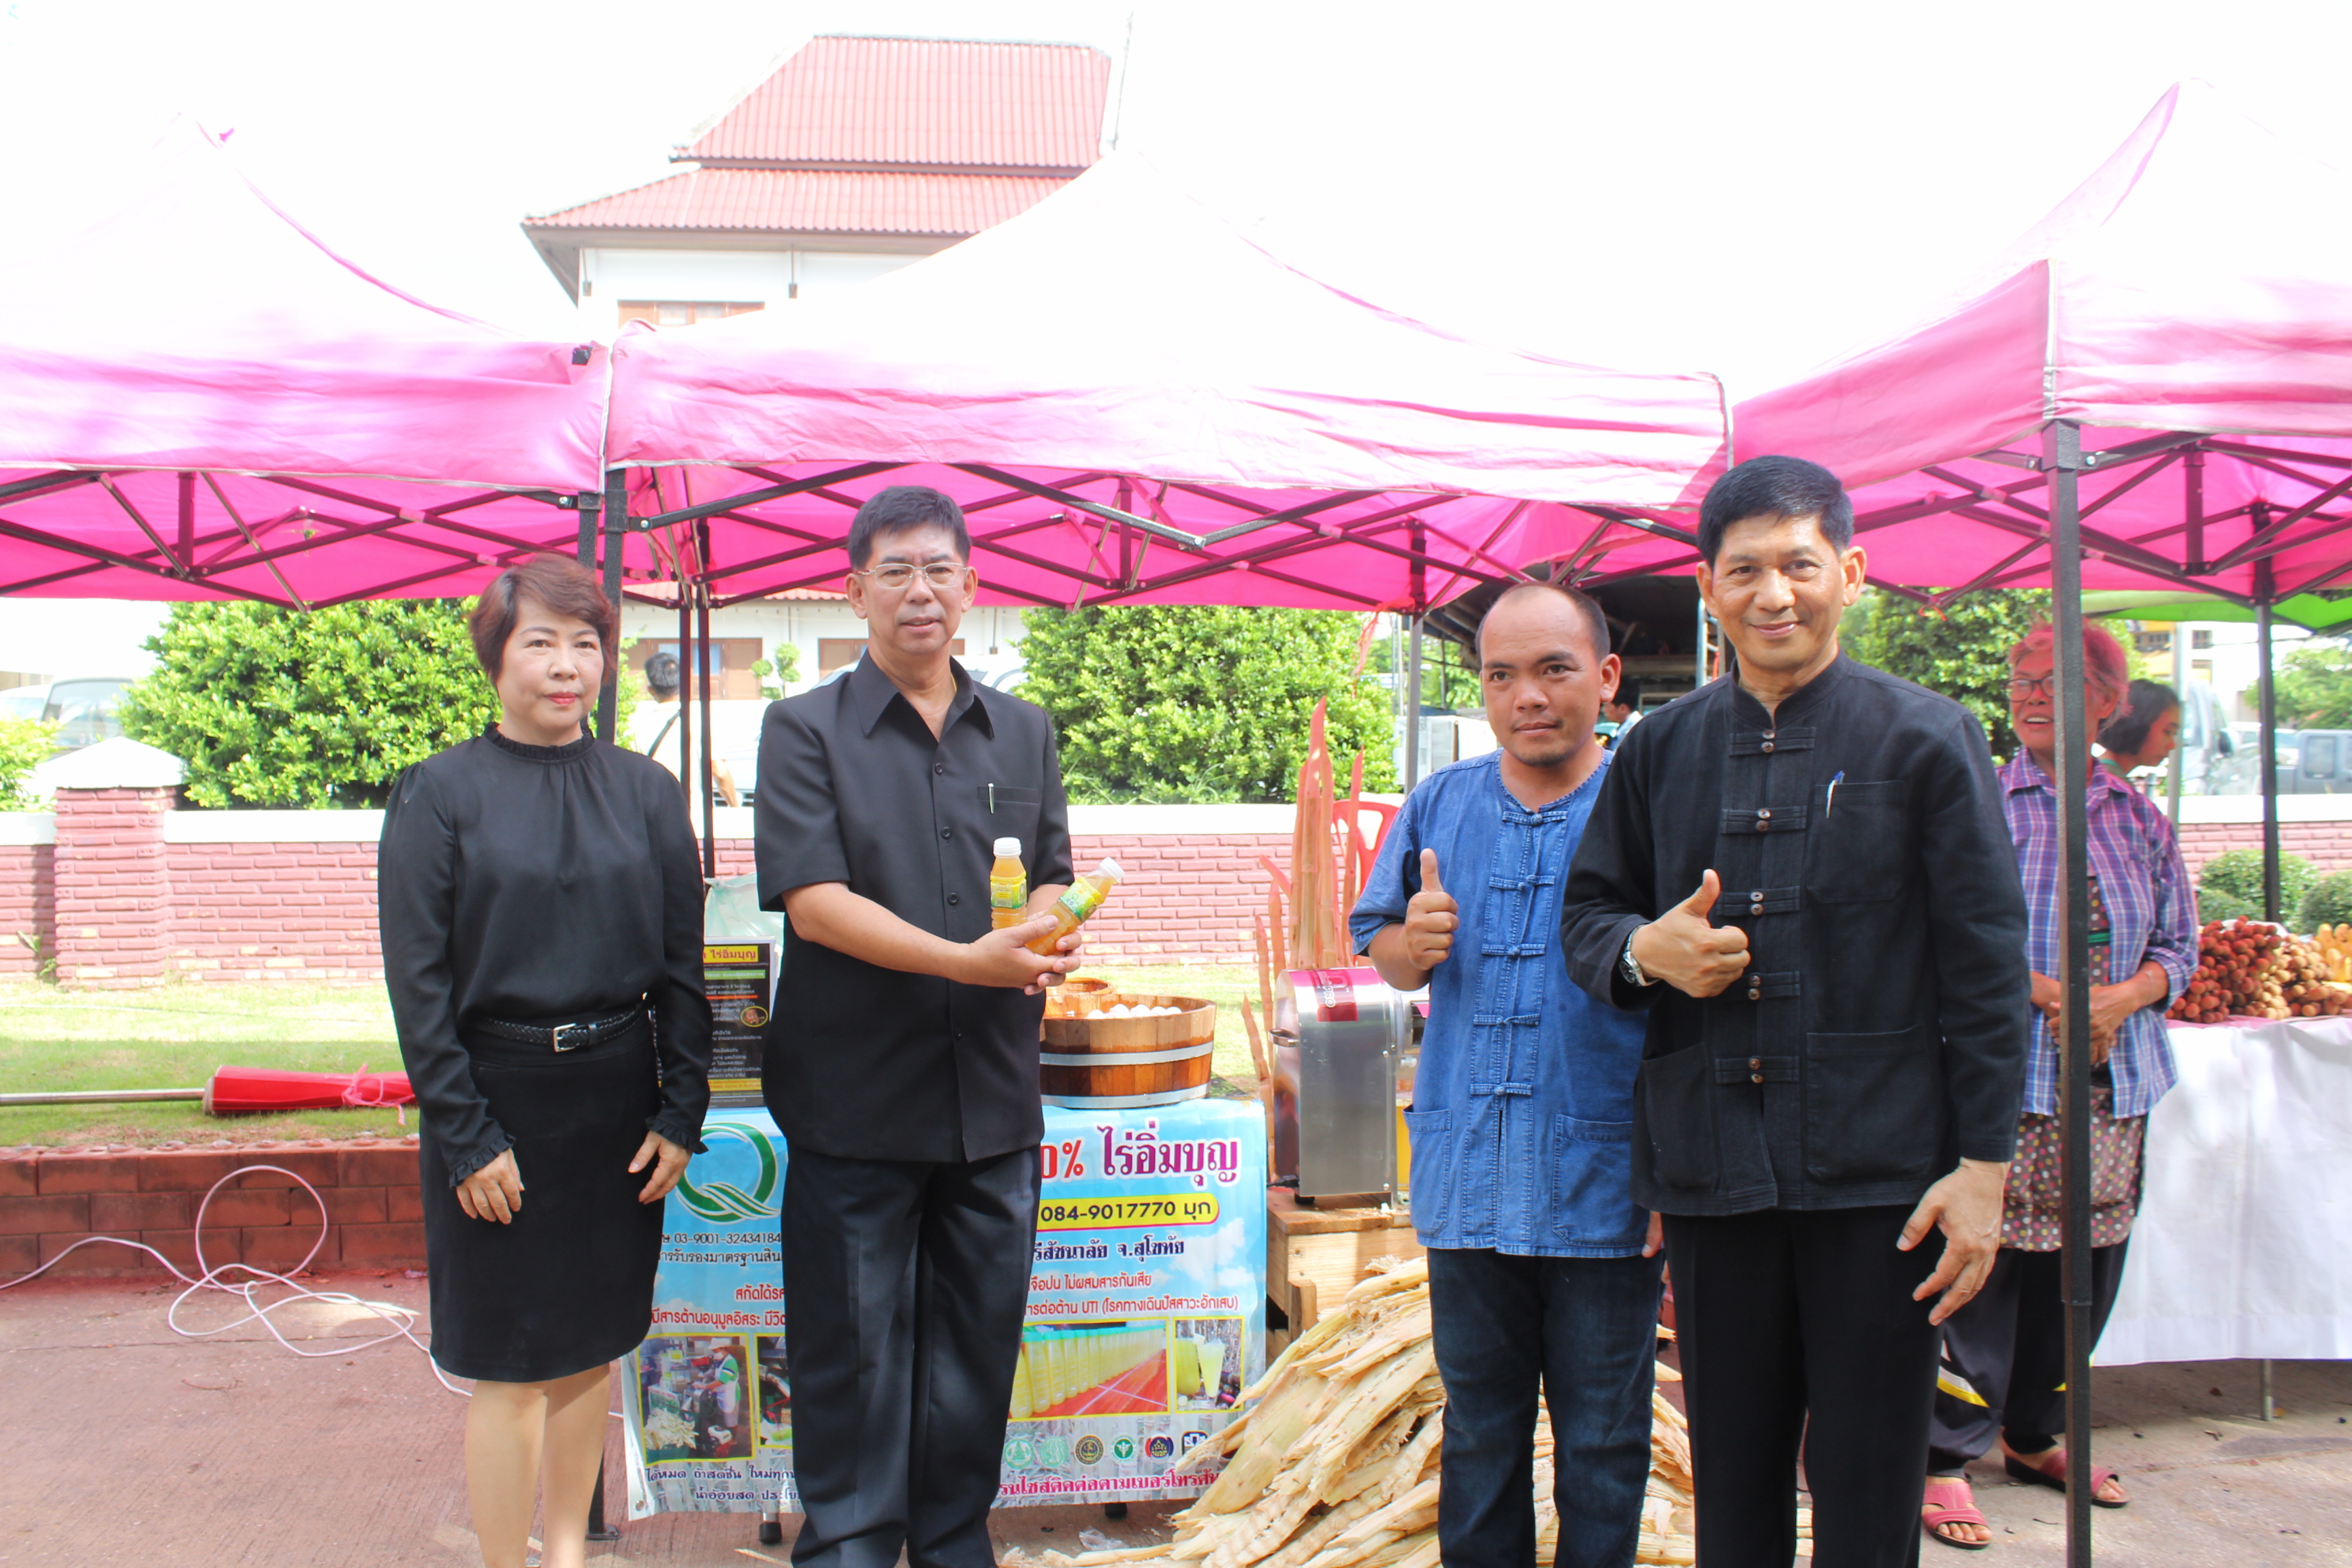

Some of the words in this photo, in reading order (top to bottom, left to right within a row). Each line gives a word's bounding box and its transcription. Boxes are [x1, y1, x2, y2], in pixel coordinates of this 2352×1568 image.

[710, 947, 756, 960] ไร่อิ่มบุญ
[1097, 1120, 1237, 1186] ไร่อิ่มบุญ
[1041, 1202, 1175, 1222] 084-9017770
[1184, 1201, 1211, 1220] มุก
[659, 1248, 782, 1267] ารรับรองมาตรฐานสิน
[1117, 1235, 1184, 1262] จ.สุโขทัย
[1028, 1275, 1061, 1291] จือปน
[1064, 1271, 1152, 1290] ไม่ผสมสารกันเสีย
[1024, 1298, 1078, 1316] ารต่อต้าน
[1082, 1301, 1098, 1313] UTI
[762, 1487, 800, 1500] ประโย
